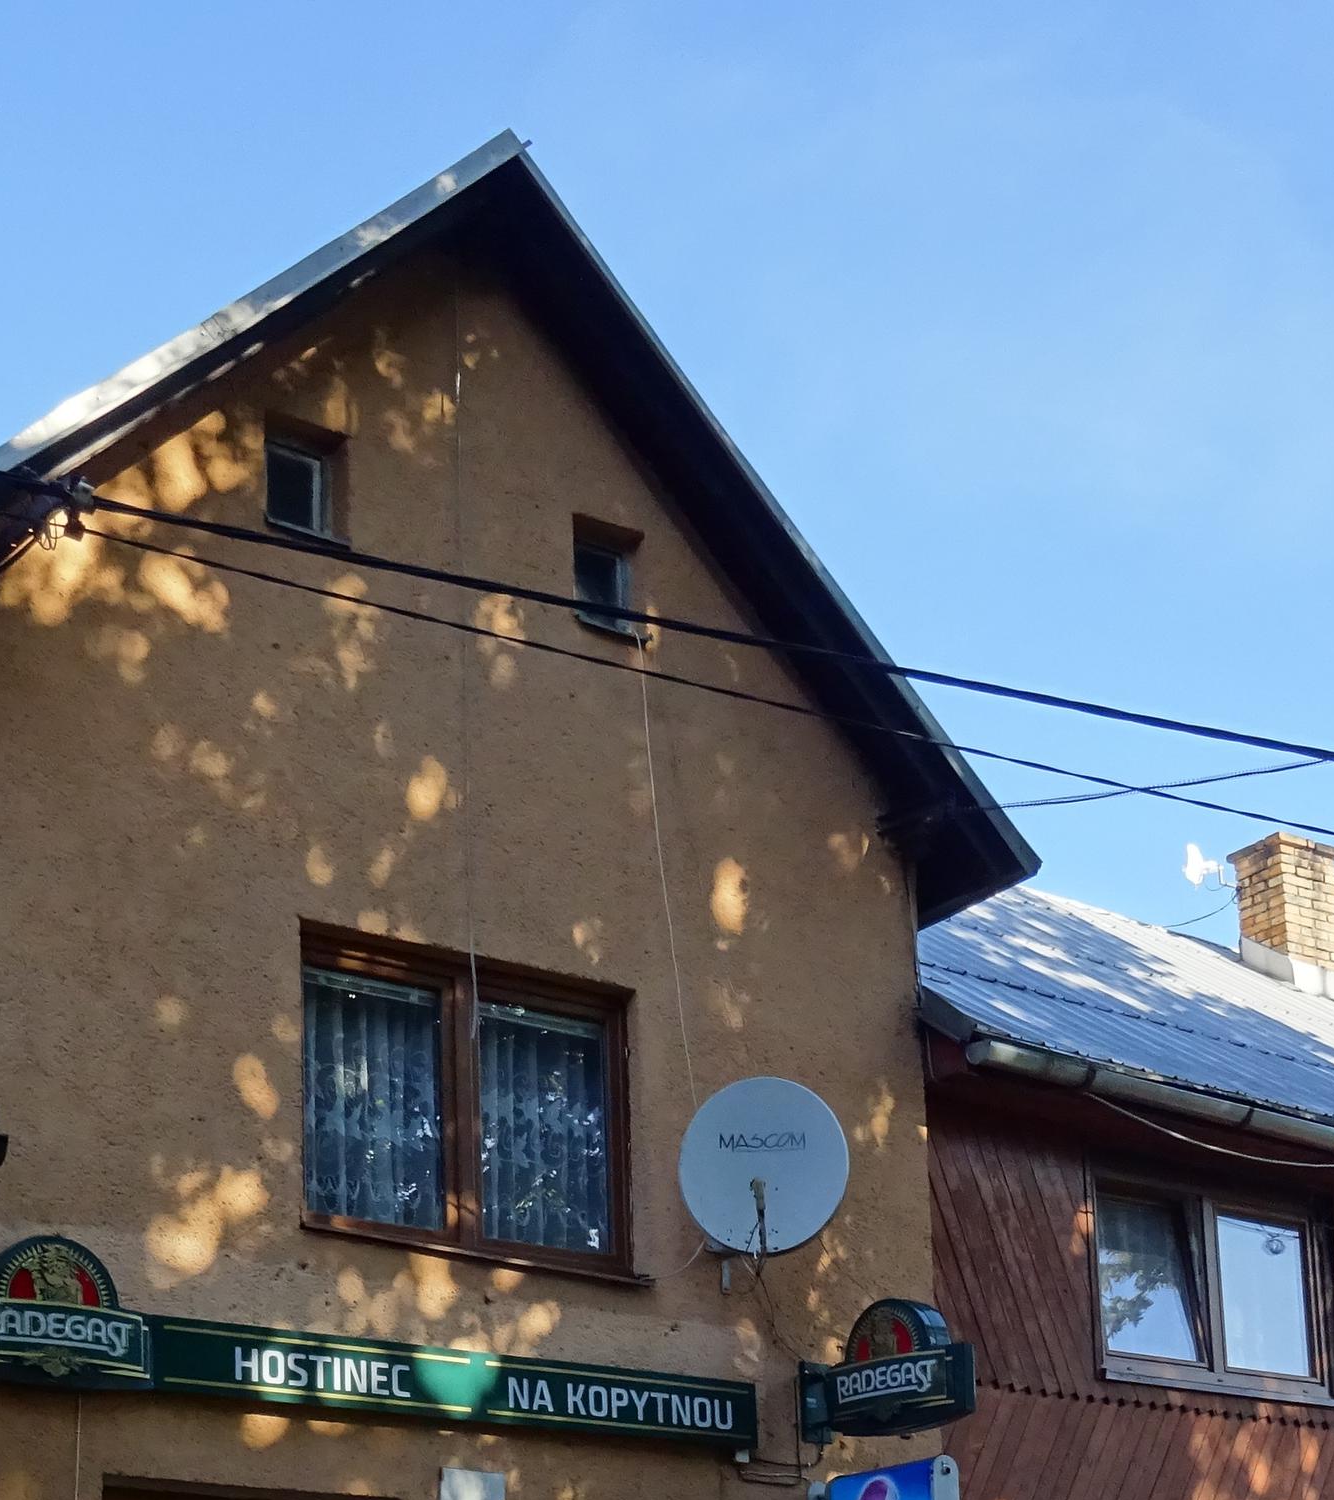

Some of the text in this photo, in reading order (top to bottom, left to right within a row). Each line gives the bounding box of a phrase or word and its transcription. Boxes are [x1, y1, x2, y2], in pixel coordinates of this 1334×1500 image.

[718, 1132, 806, 1151] MASCOM
[234, 1346, 734, 1430] HOSTINEC NA KOPYTNOU
[836, 1359, 938, 1404] RADEGAST
